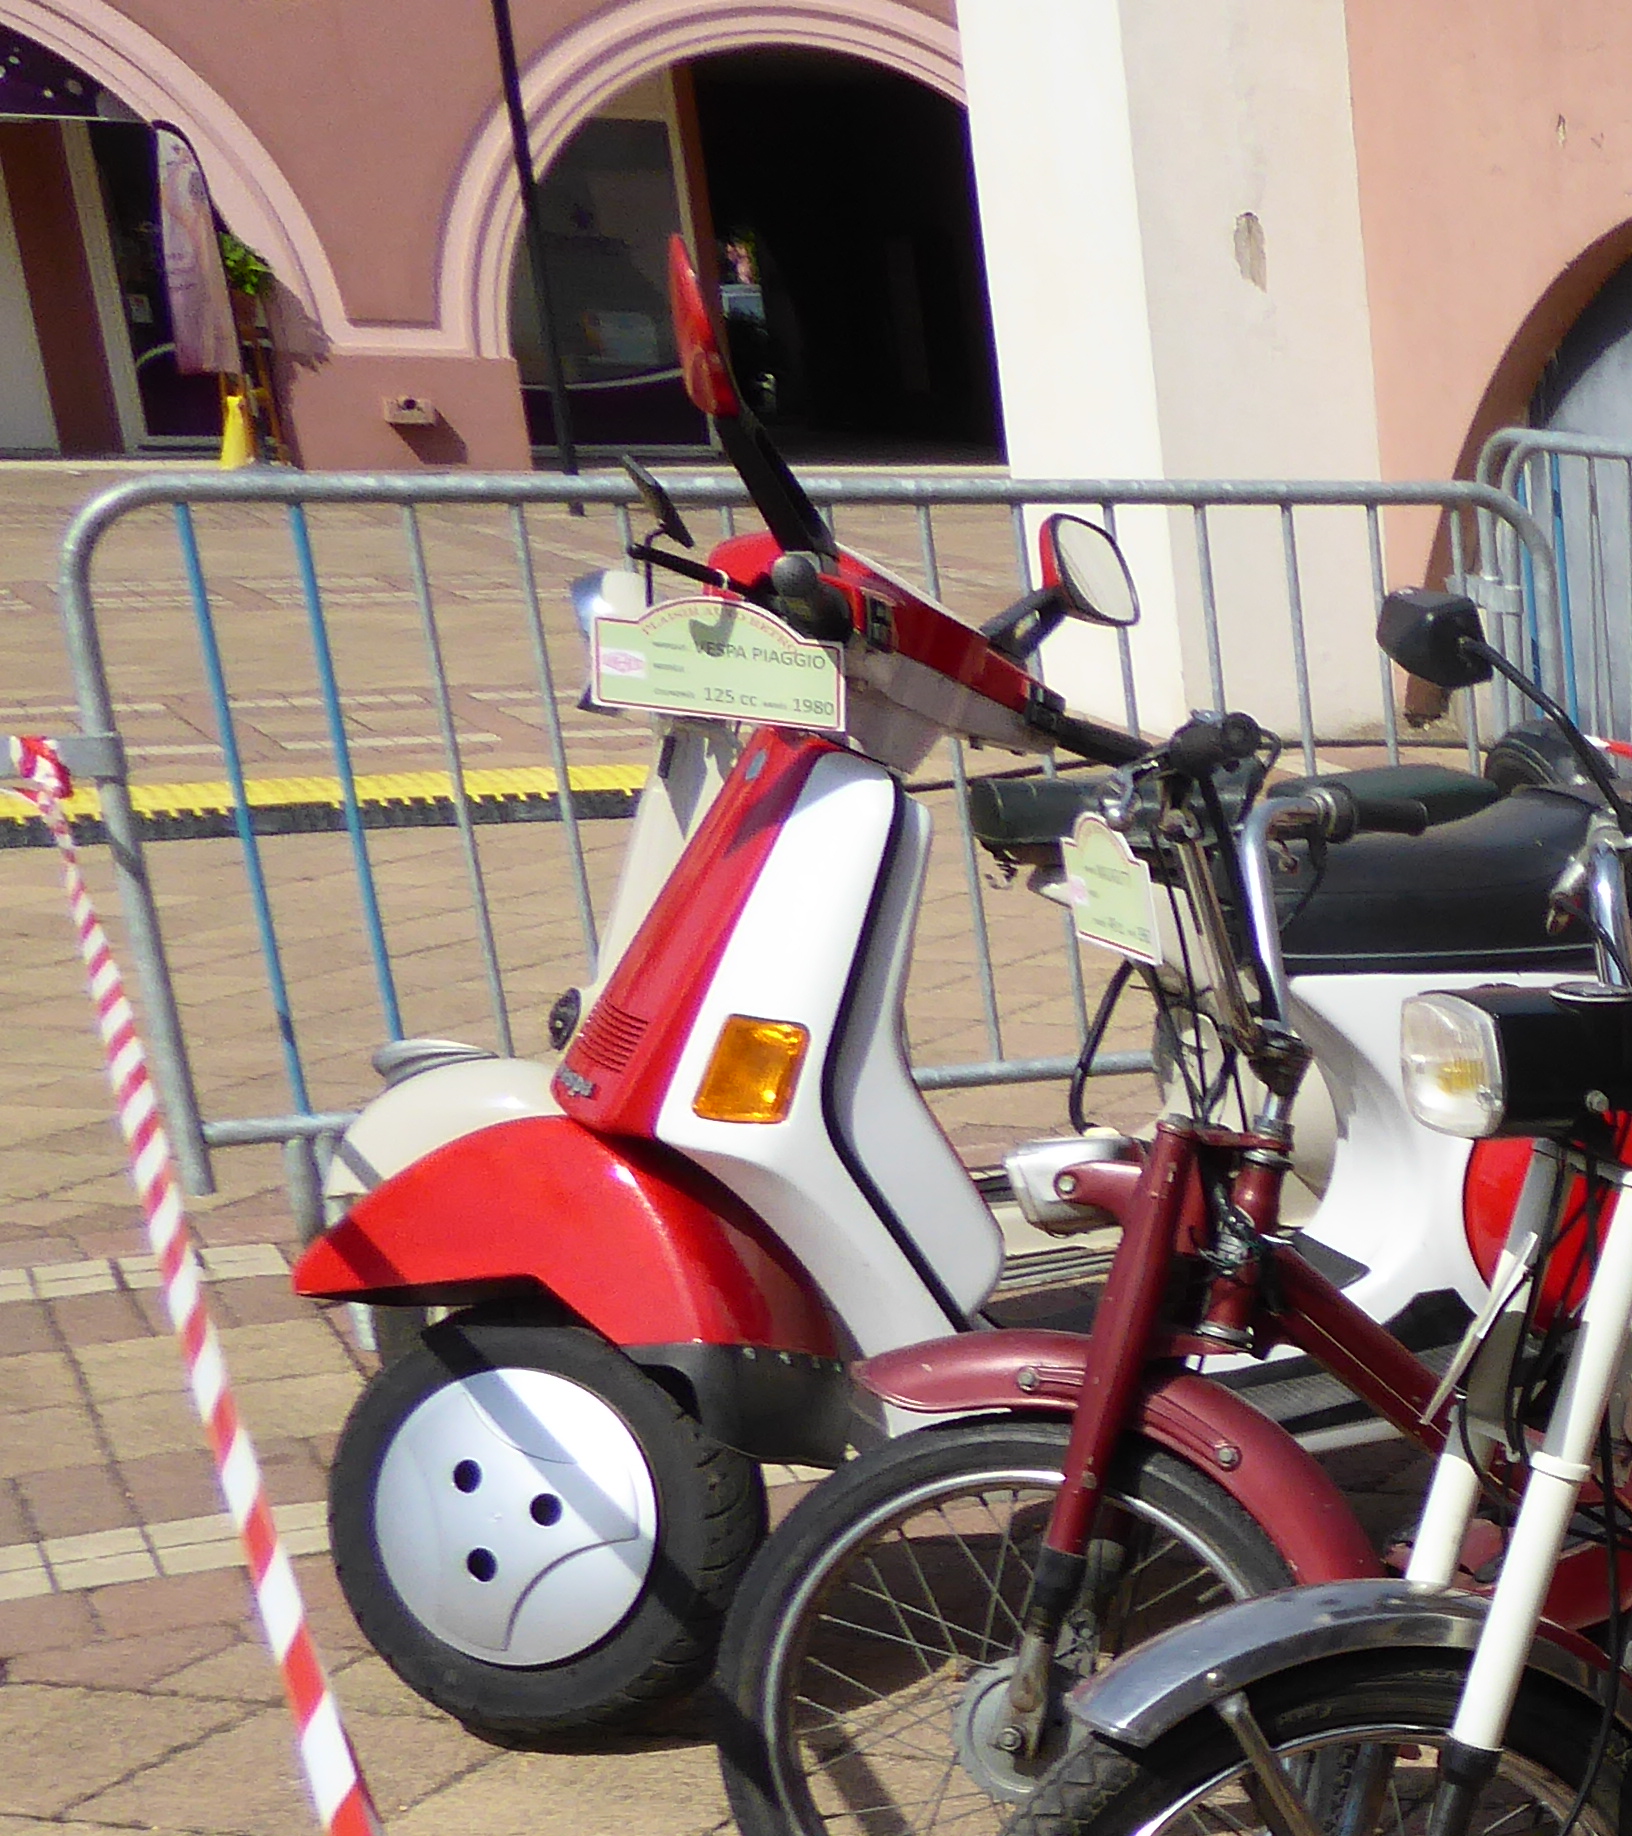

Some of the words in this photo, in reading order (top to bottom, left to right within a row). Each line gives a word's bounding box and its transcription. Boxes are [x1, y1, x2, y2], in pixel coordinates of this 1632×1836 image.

[697, 639, 748, 662] VESPA
[752, 645, 827, 671] PIAGGIO
[703, 686, 735, 704] 125
[791, 698, 835, 717] 1980
